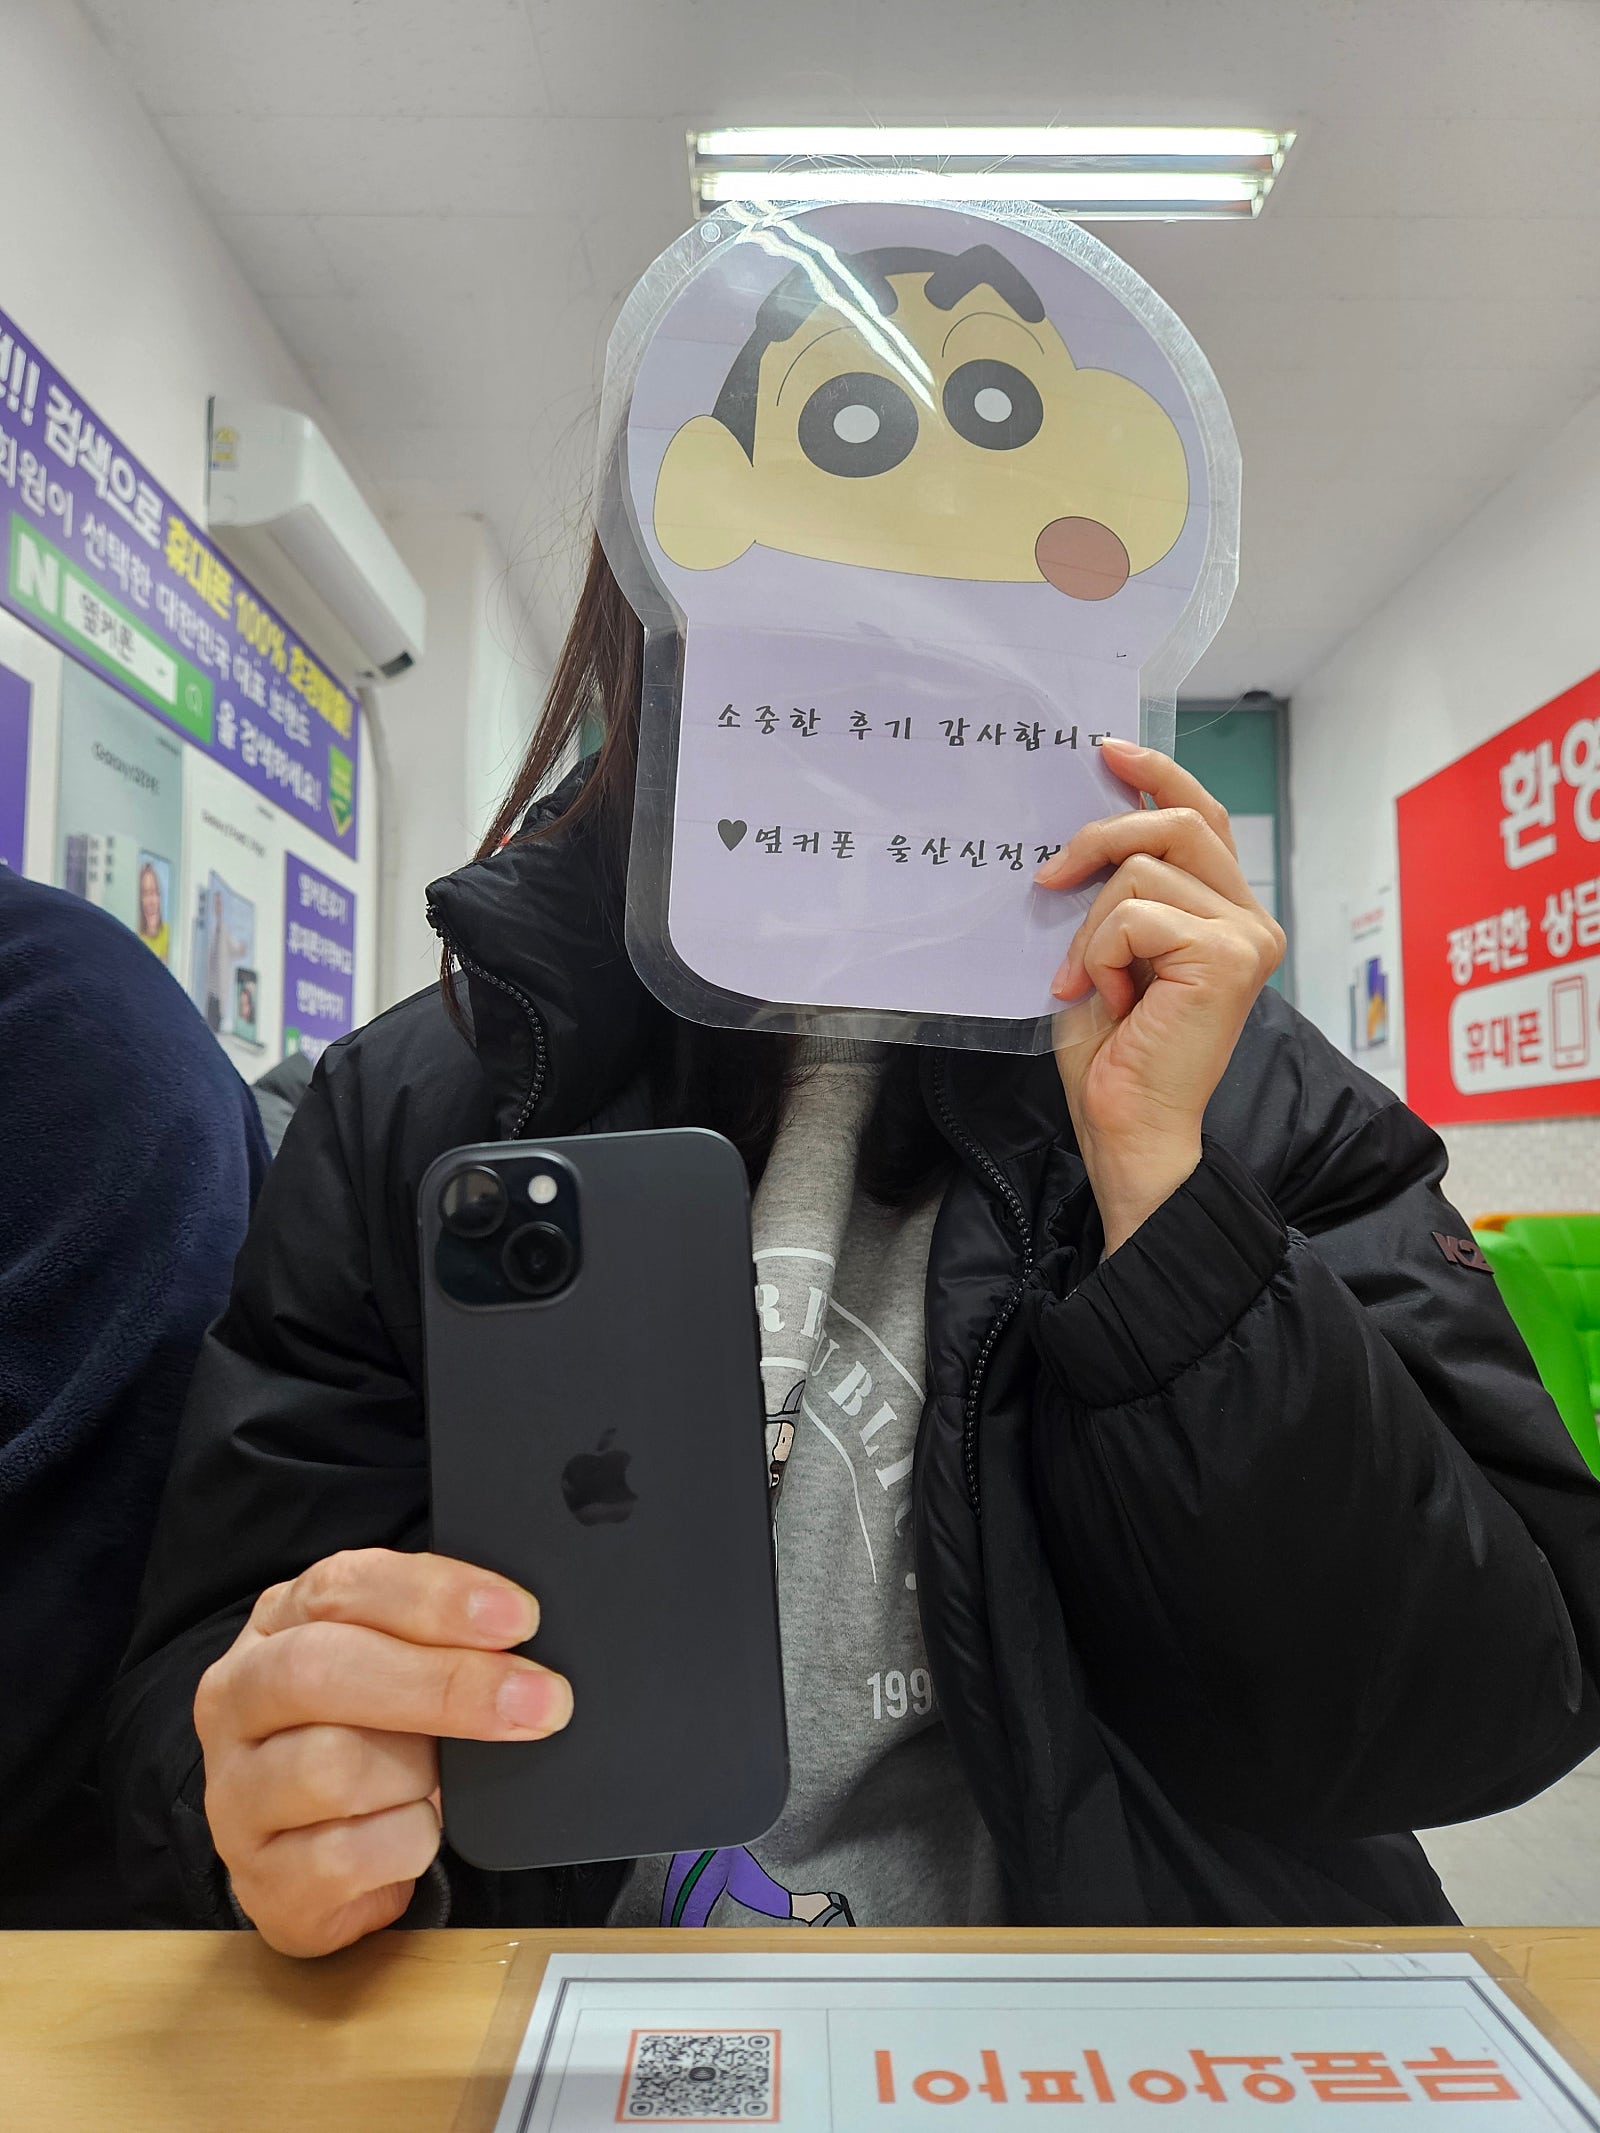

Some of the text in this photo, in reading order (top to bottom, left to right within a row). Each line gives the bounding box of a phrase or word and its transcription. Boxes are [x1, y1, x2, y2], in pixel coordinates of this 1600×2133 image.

[44, 384, 163, 550] 검색으로
[80, 512, 153, 609] 선택한
[155, 582, 231, 681] 대한민국
[717, 703, 821, 737] 소중한
[848, 710, 912, 741] 후기
[755, 826, 856, 859] 옆커폰
[1447, 905, 1530, 986] 정직한
[1466, 1010, 1540, 1073] 휴대폰
[1431, 1231, 1494, 1275] K2
[866, 1667, 940, 1720] 199
[874, 2047, 1521, 2104] 무료와이파이
